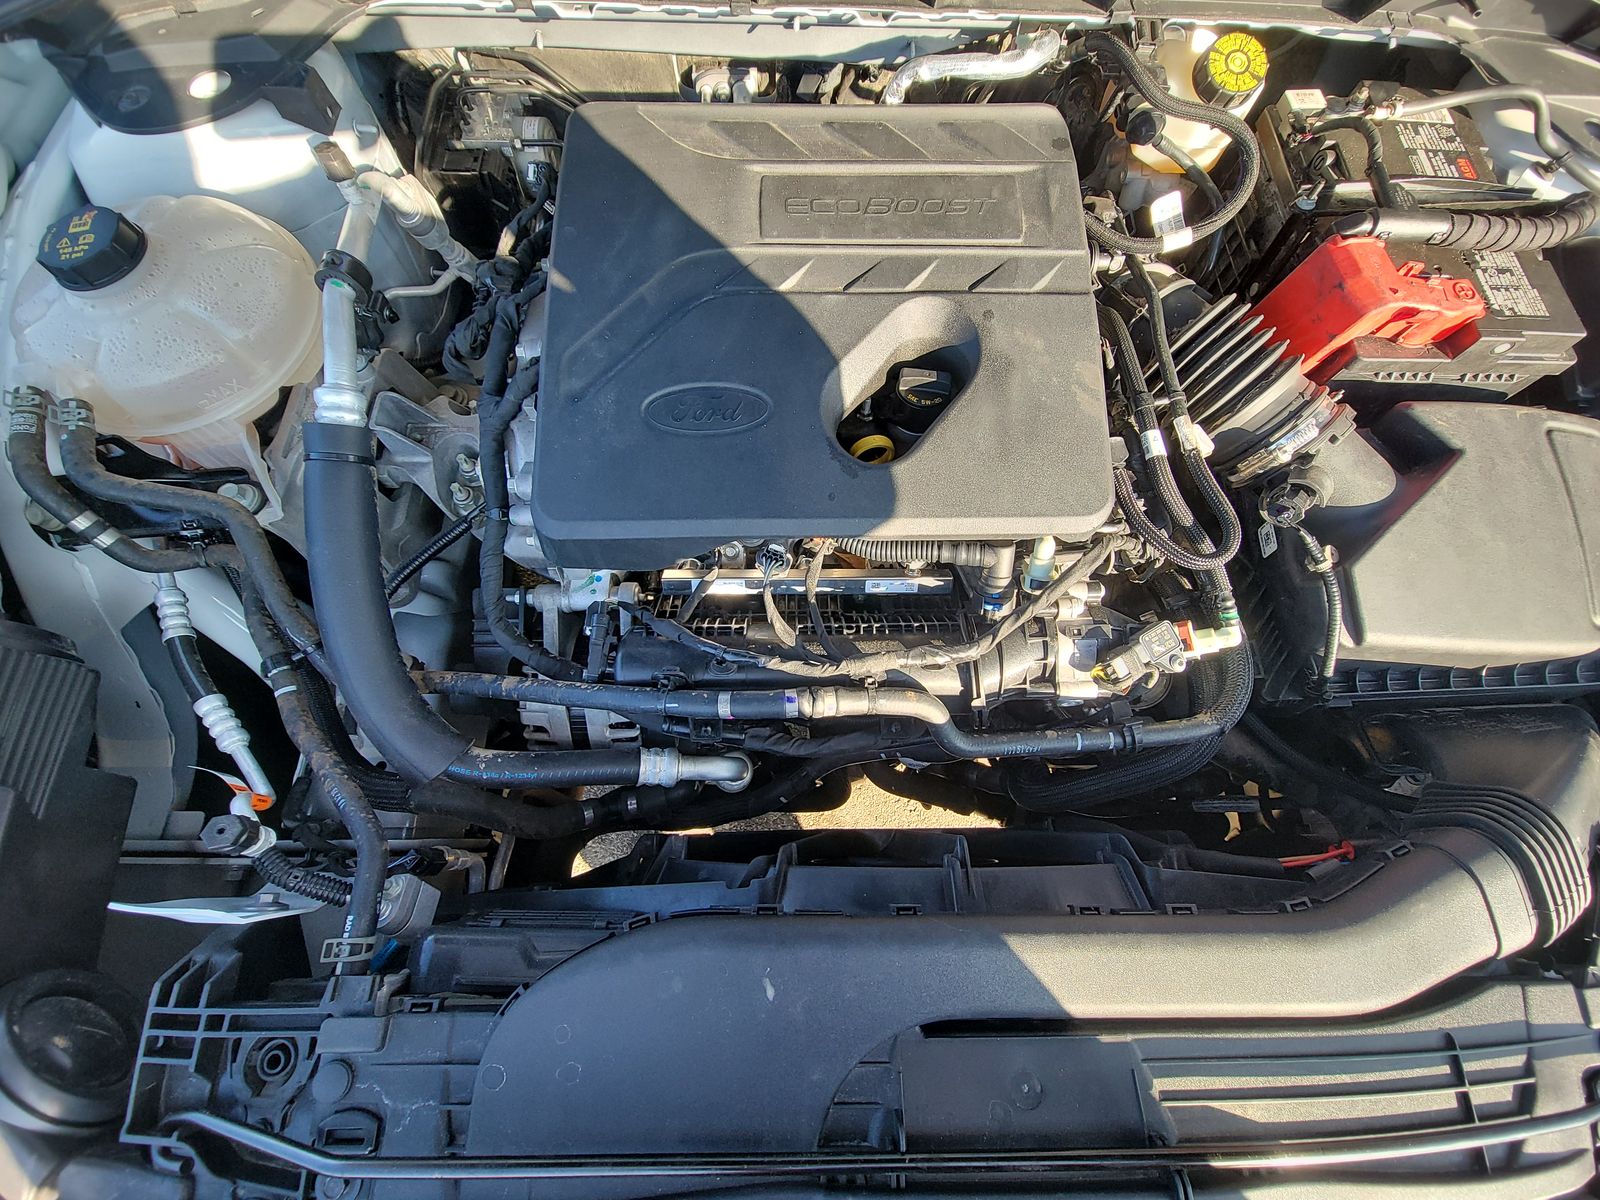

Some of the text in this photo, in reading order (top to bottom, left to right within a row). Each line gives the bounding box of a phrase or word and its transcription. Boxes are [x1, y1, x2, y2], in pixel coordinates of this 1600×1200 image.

[1456, 158, 1475, 179] AGM
[669, 395, 744, 423] Ford
[448, 765, 471, 776] HOSE
[345, 915, 354, 931] RAD
